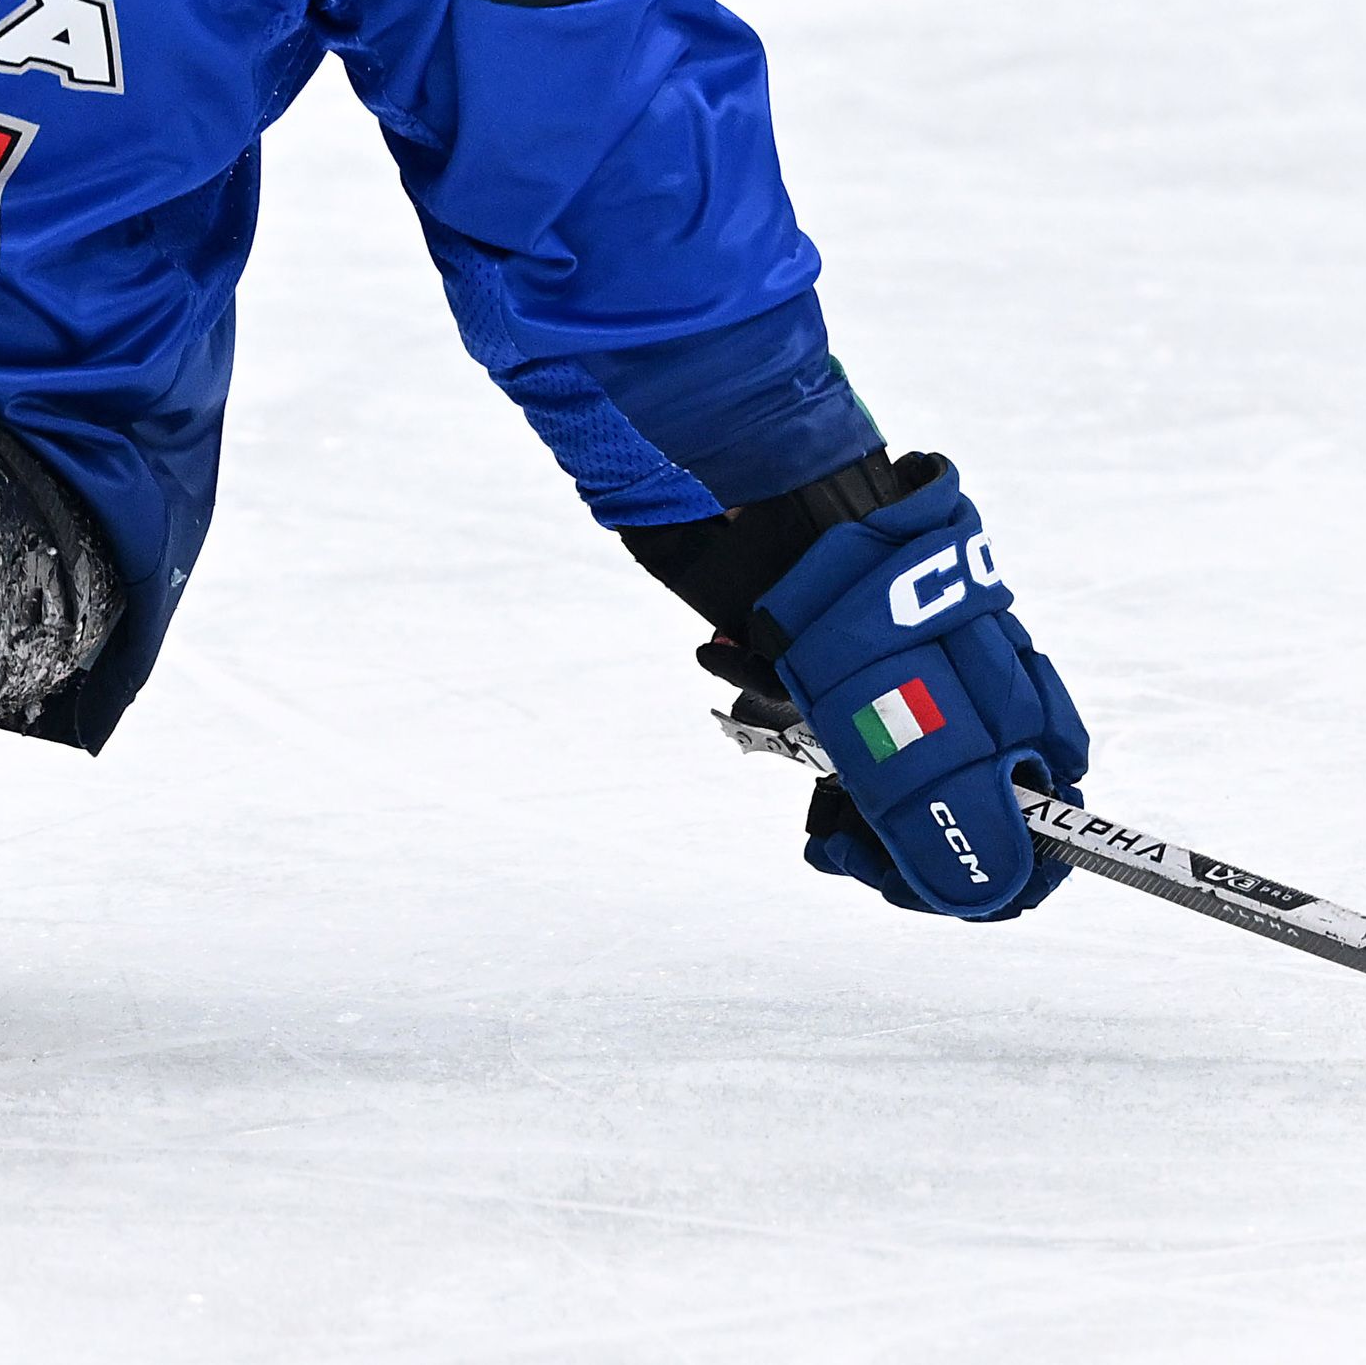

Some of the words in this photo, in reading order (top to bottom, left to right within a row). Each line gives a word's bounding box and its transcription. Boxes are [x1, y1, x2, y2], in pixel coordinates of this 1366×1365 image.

[930, 801, 990, 884] CCM
[1022, 799, 1167, 863] ALPHA
[1259, 886, 1292, 902] PRO
